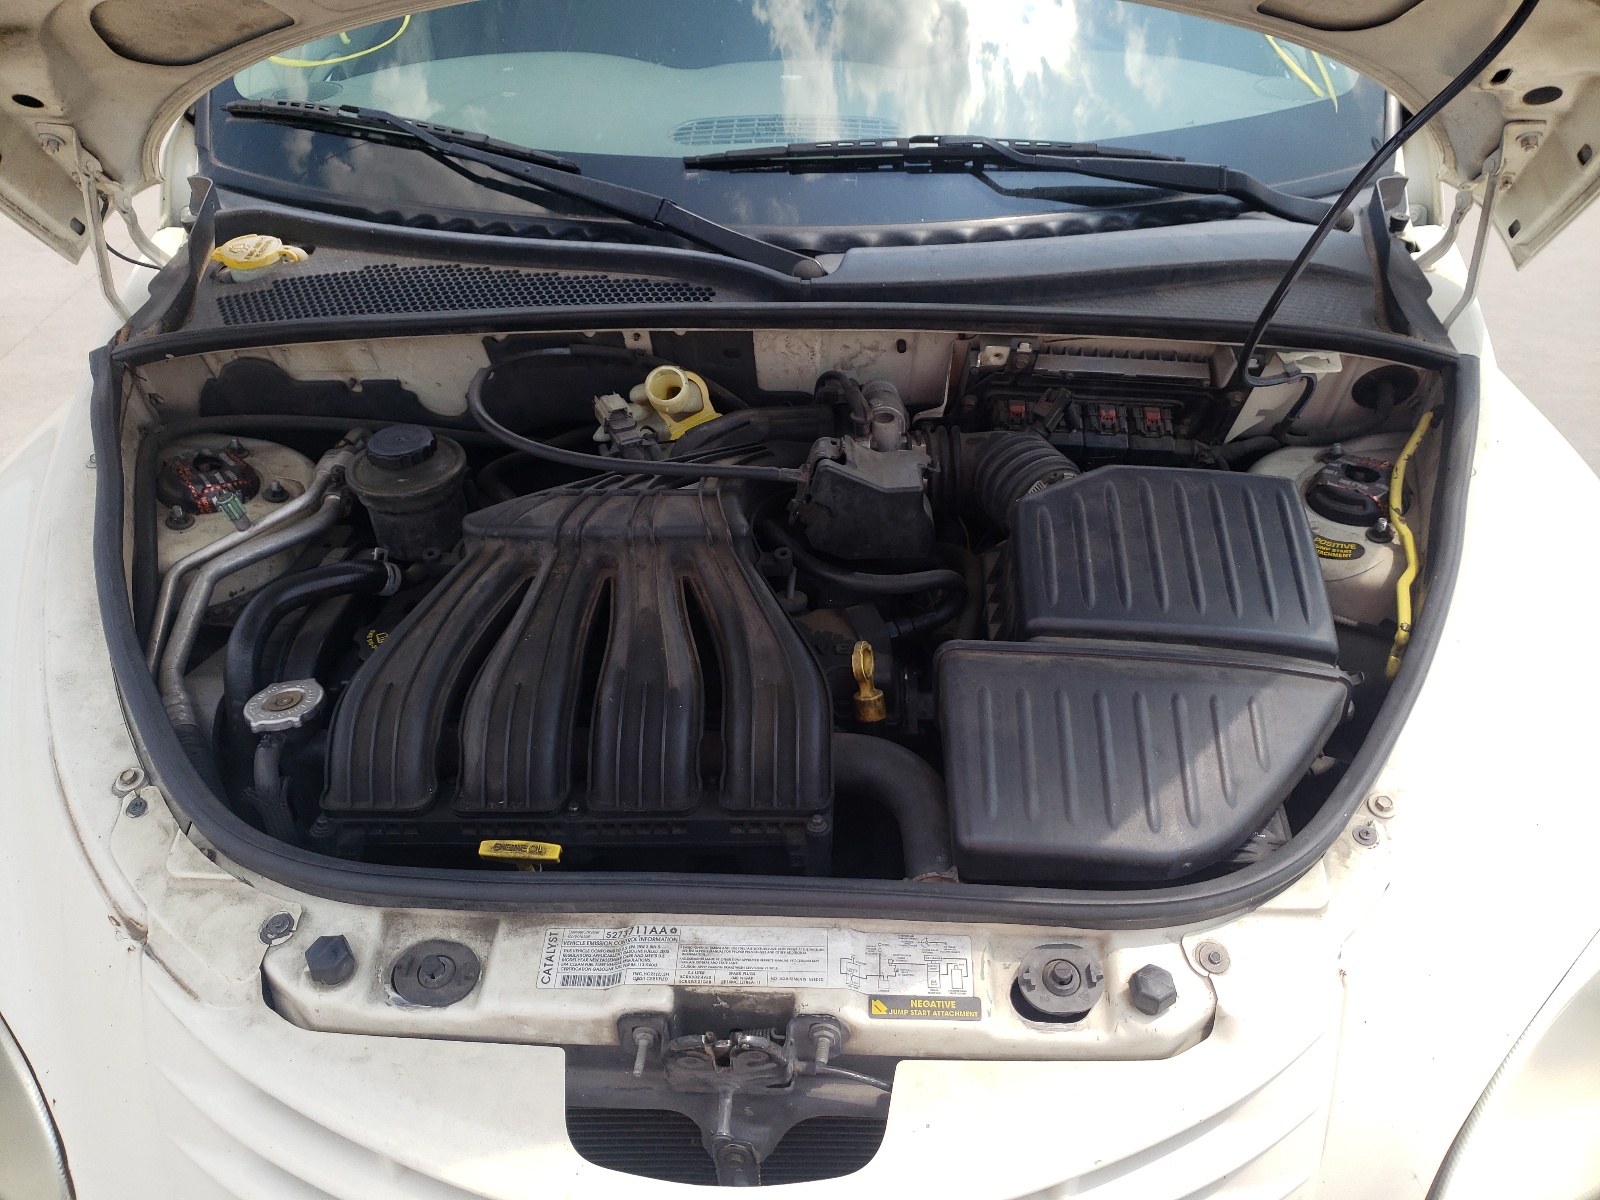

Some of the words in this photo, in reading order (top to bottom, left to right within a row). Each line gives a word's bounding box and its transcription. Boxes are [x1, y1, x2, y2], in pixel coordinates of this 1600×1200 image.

[1314, 537, 1357, 549] POSITIVE
[1317, 549, 1352, 558] TACHMENT
[491, 843, 528, 853] ENGINE
[528, 845, 545, 854] OIL
[541, 931, 559, 985] CATALYST
[910, 1000, 956, 1008] NEGATIVE
[932, 1010, 979, 1018] ATTACHMENT
